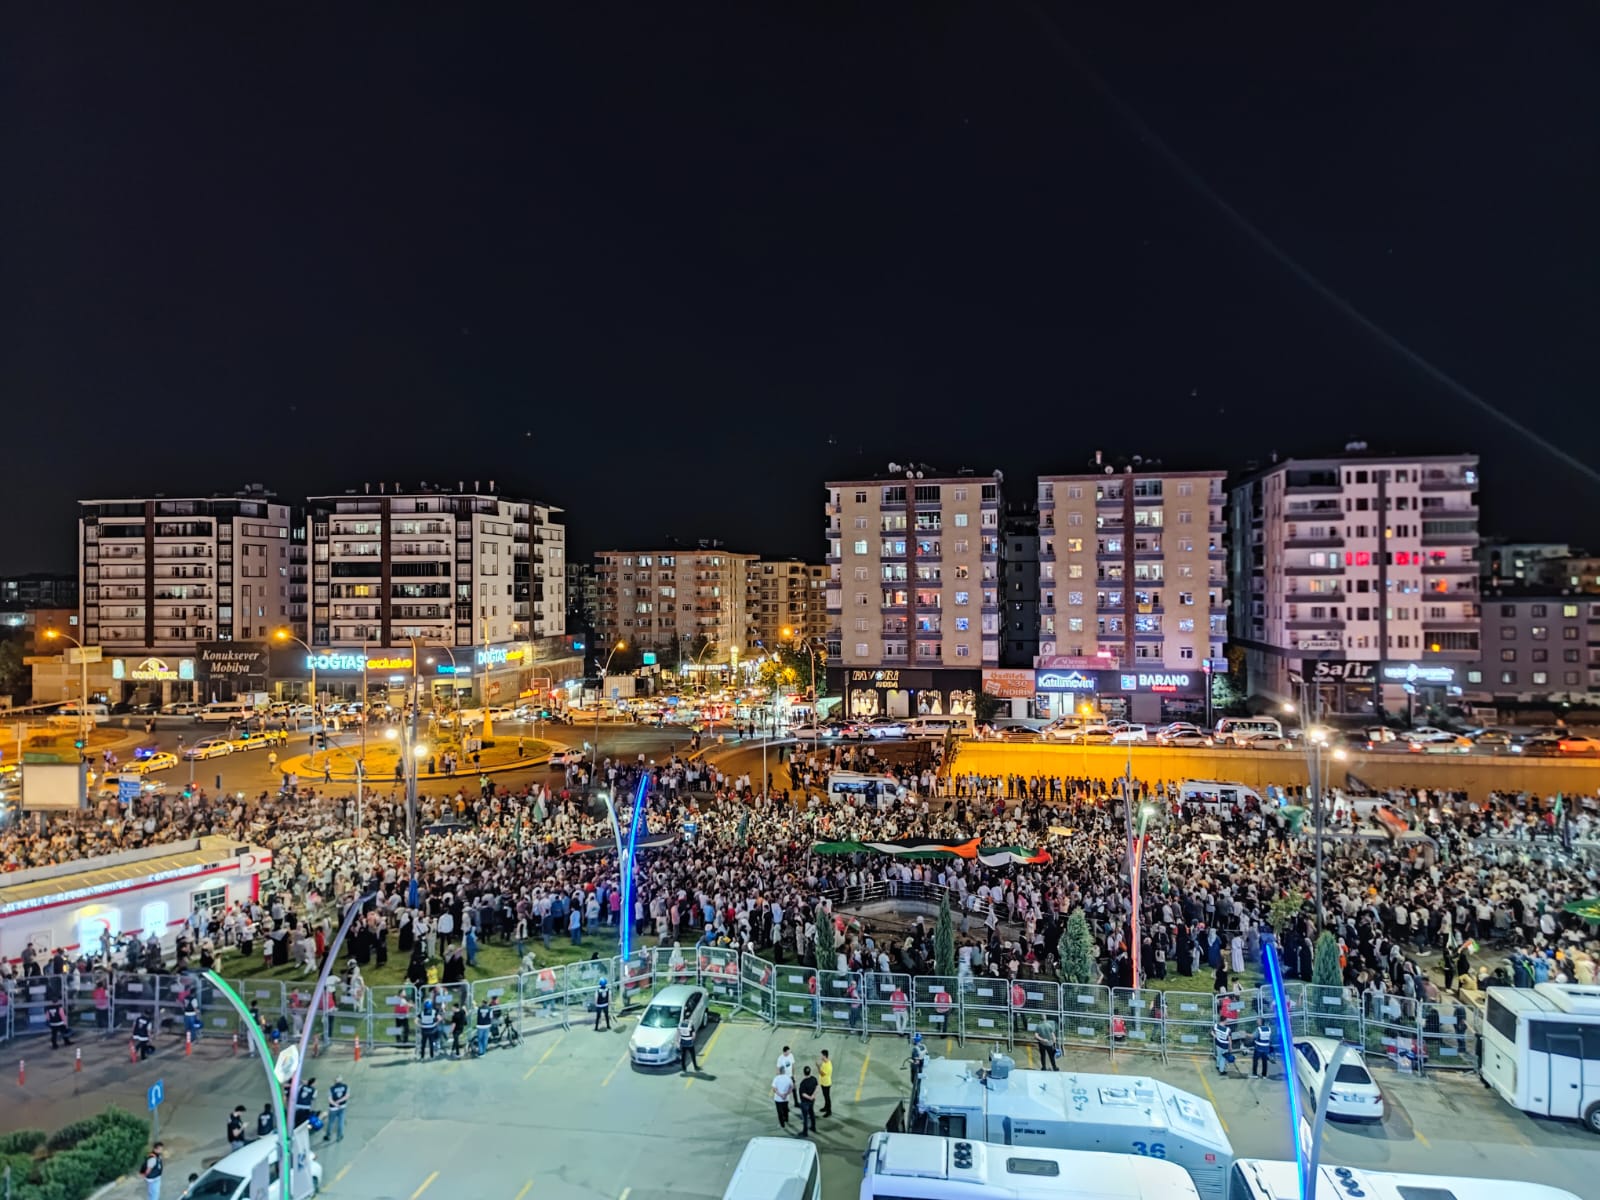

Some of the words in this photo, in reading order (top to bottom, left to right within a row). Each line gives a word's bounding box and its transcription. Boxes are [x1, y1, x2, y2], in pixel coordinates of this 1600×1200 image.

[202, 650, 260, 661] Konuksever
[306, 653, 364, 671] DOĞTAŞ
[366, 657, 413, 669] exclusive
[210, 661, 250, 675] Mobilya
[1314, 661, 1372, 678] Safir
[1139, 674, 1189, 686] BARANO
[1132, 1141, 1166, 1159] 36
